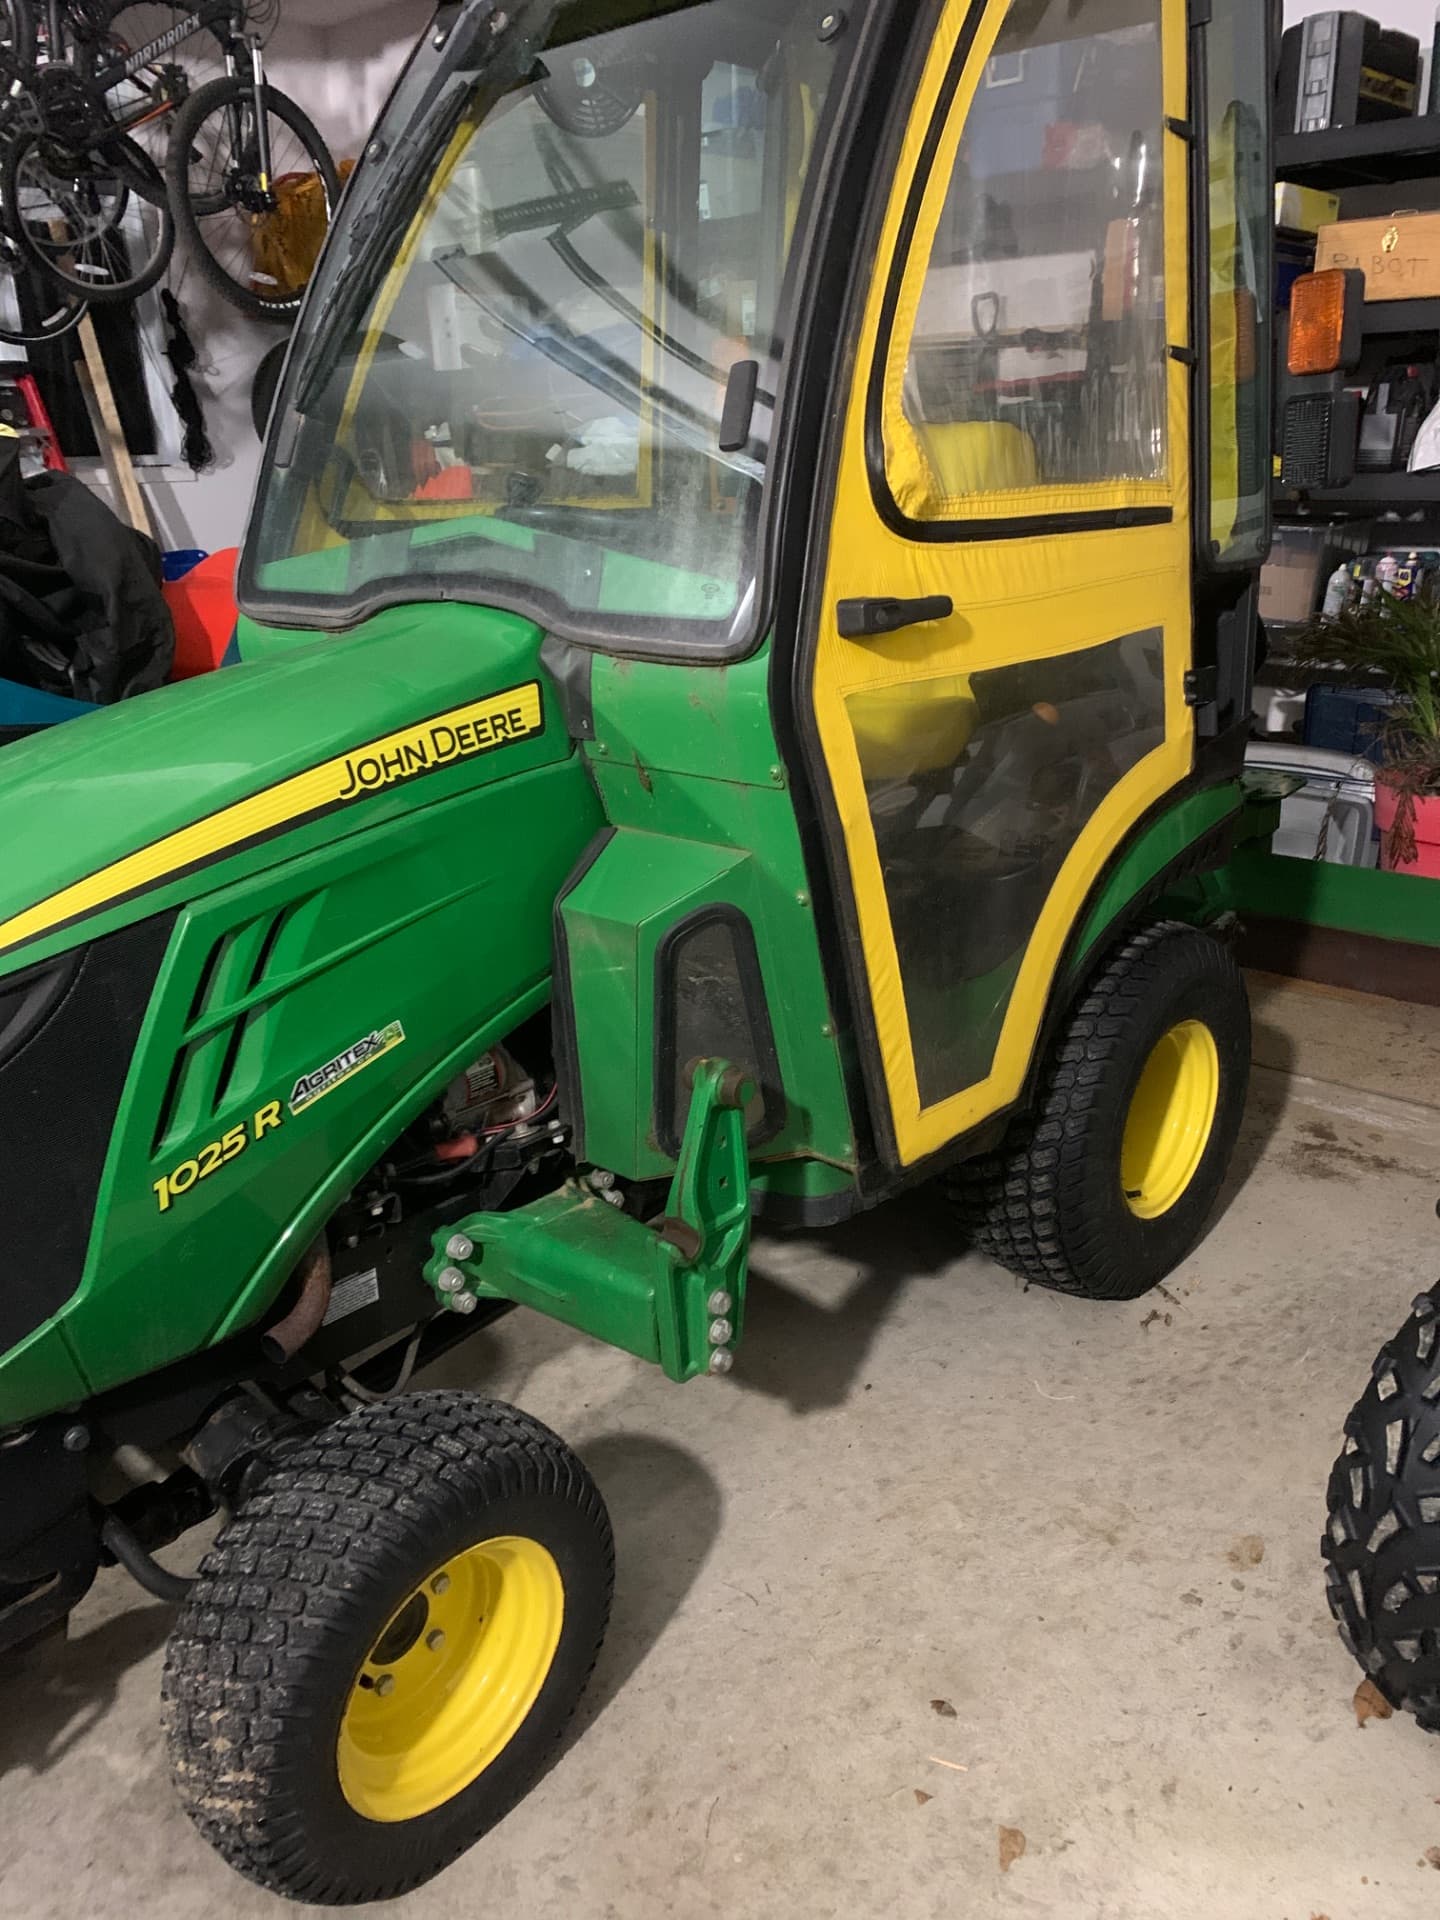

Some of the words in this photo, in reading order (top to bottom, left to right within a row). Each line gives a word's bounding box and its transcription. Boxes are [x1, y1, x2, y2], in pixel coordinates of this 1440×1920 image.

[126, 12, 200, 75] NORTHROCK
[340, 739, 428, 796] JOHN
[430, 708, 526, 758] DEERE
[291, 1034, 378, 1103] AGRITEX
[153, 1123, 248, 1212] 1025
[254, 1100, 281, 1140] R
